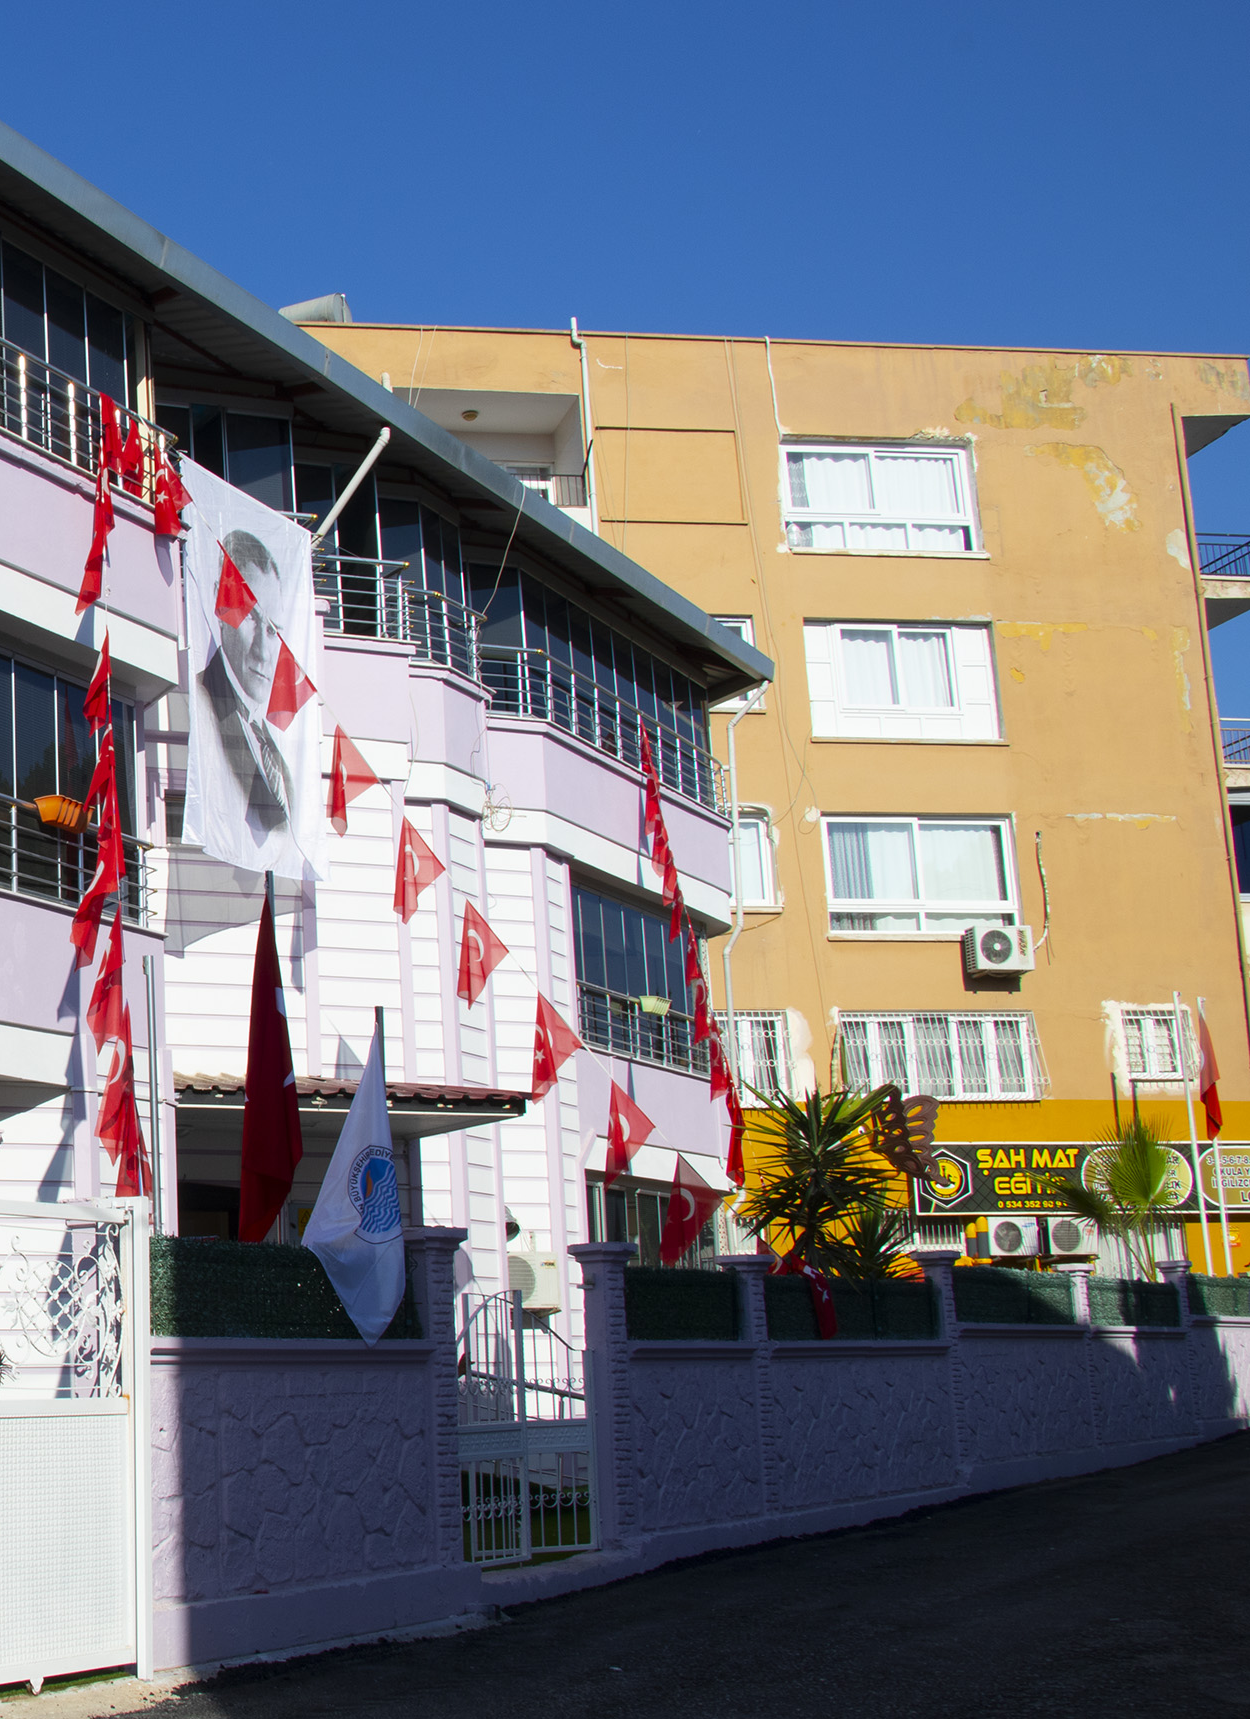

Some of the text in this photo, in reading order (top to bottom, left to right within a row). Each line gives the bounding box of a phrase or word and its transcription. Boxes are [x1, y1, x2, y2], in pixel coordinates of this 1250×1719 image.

[976, 1148, 1027, 1176] ŞAH
[1031, 1148, 1080, 1169] MAT
[1213, 1167, 1243, 1176] KULA
[994, 1171, 1067, 1195] EĞİTİ
[1212, 1177, 1250, 1188] İGİLİZC
[997, 1200, 1004, 1209] 0
[1005, 1200, 1023, 1209] 534
[1024, 1200, 1042, 1209] 352
